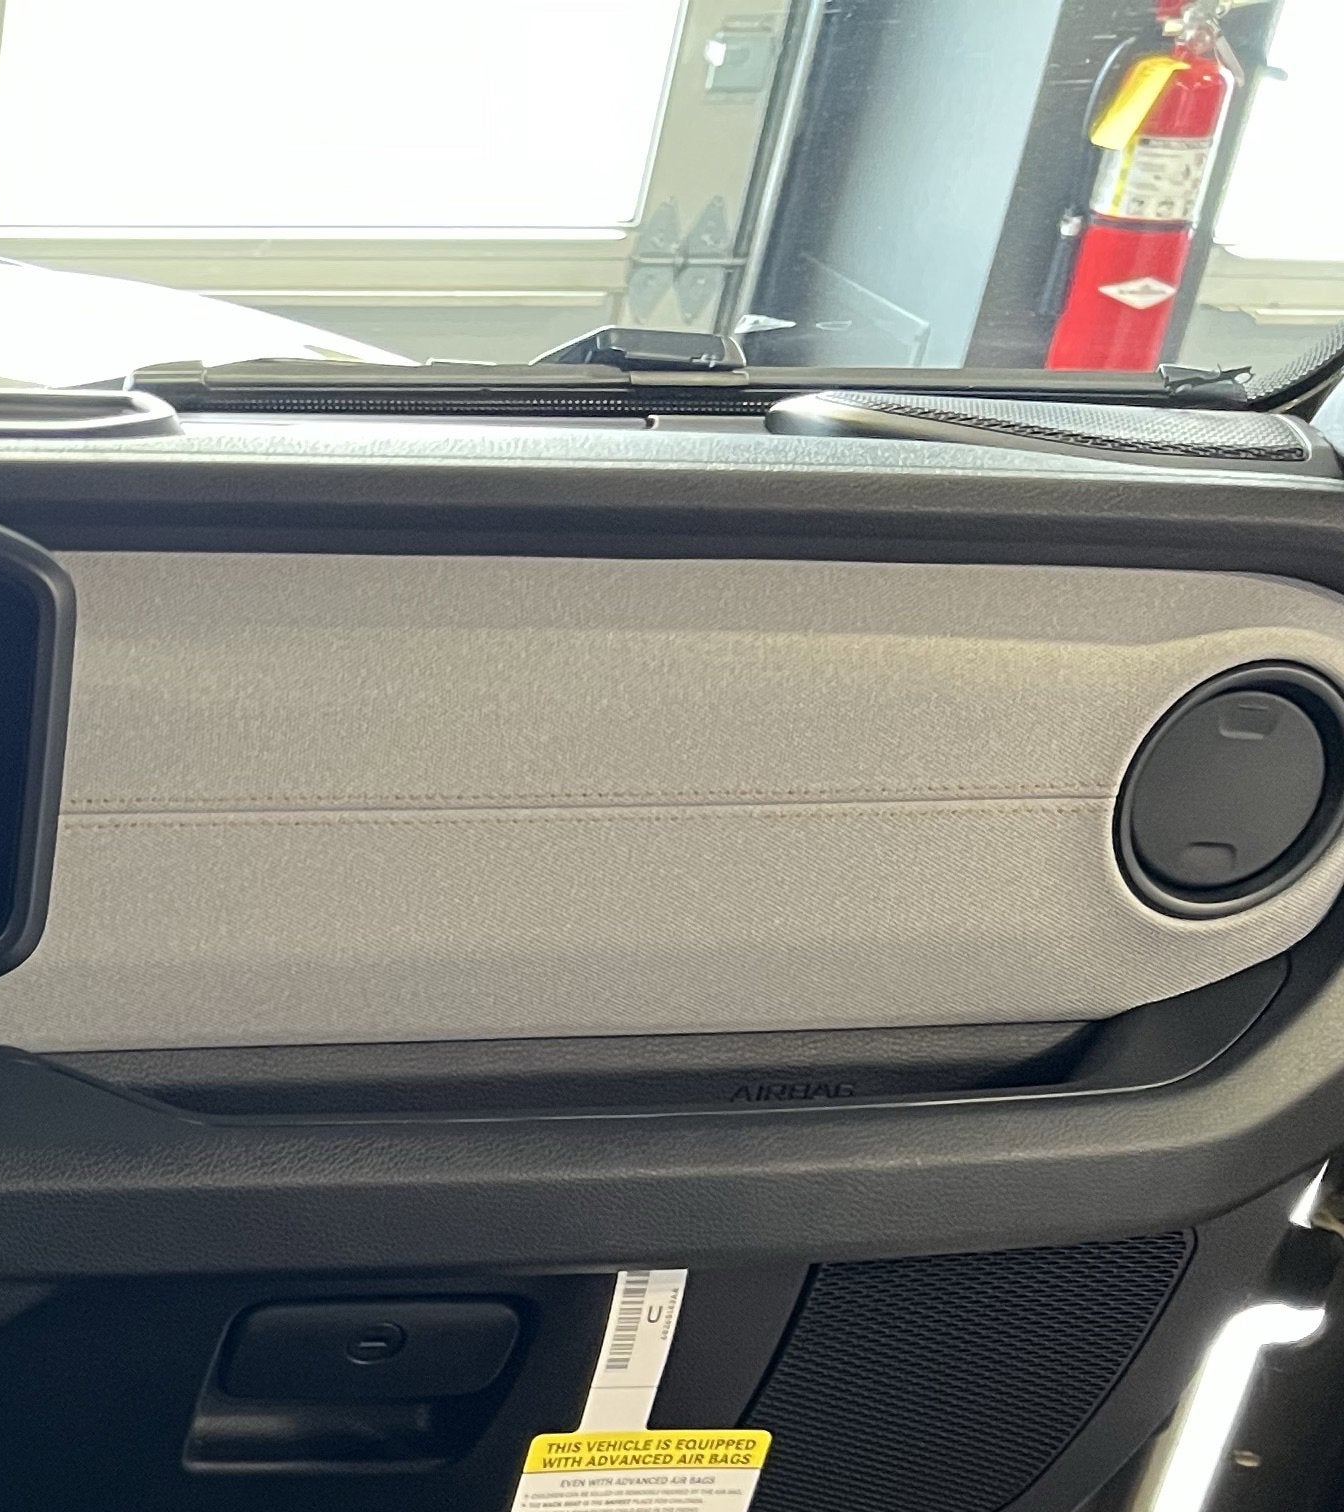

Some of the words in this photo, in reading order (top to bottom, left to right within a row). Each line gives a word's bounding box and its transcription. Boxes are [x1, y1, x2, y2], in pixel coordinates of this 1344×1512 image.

[730, 1083, 857, 1102] AIRBAG
[647, 1305, 663, 1324] U
[546, 1441, 582, 1455] THIS
[586, 1438, 653, 1453] VEHICLE
[656, 1438, 672, 1451] IS
[675, 1438, 757, 1451] EQUIPPED
[542, 1455, 582, 1469] WITH
[585, 1453, 673, 1468] ADVANCED
[676, 1453, 704, 1465] AIR
[708, 1452, 753, 1465] BAGS
[560, 1478, 586, 1488] EVEN
[587, 1477, 613, 1487] WITH
[614, 1476, 668, 1486] ADVANCED
[670, 1476, 688, 1486] AIR
[689, 1475, 716, 1485] BAGS
